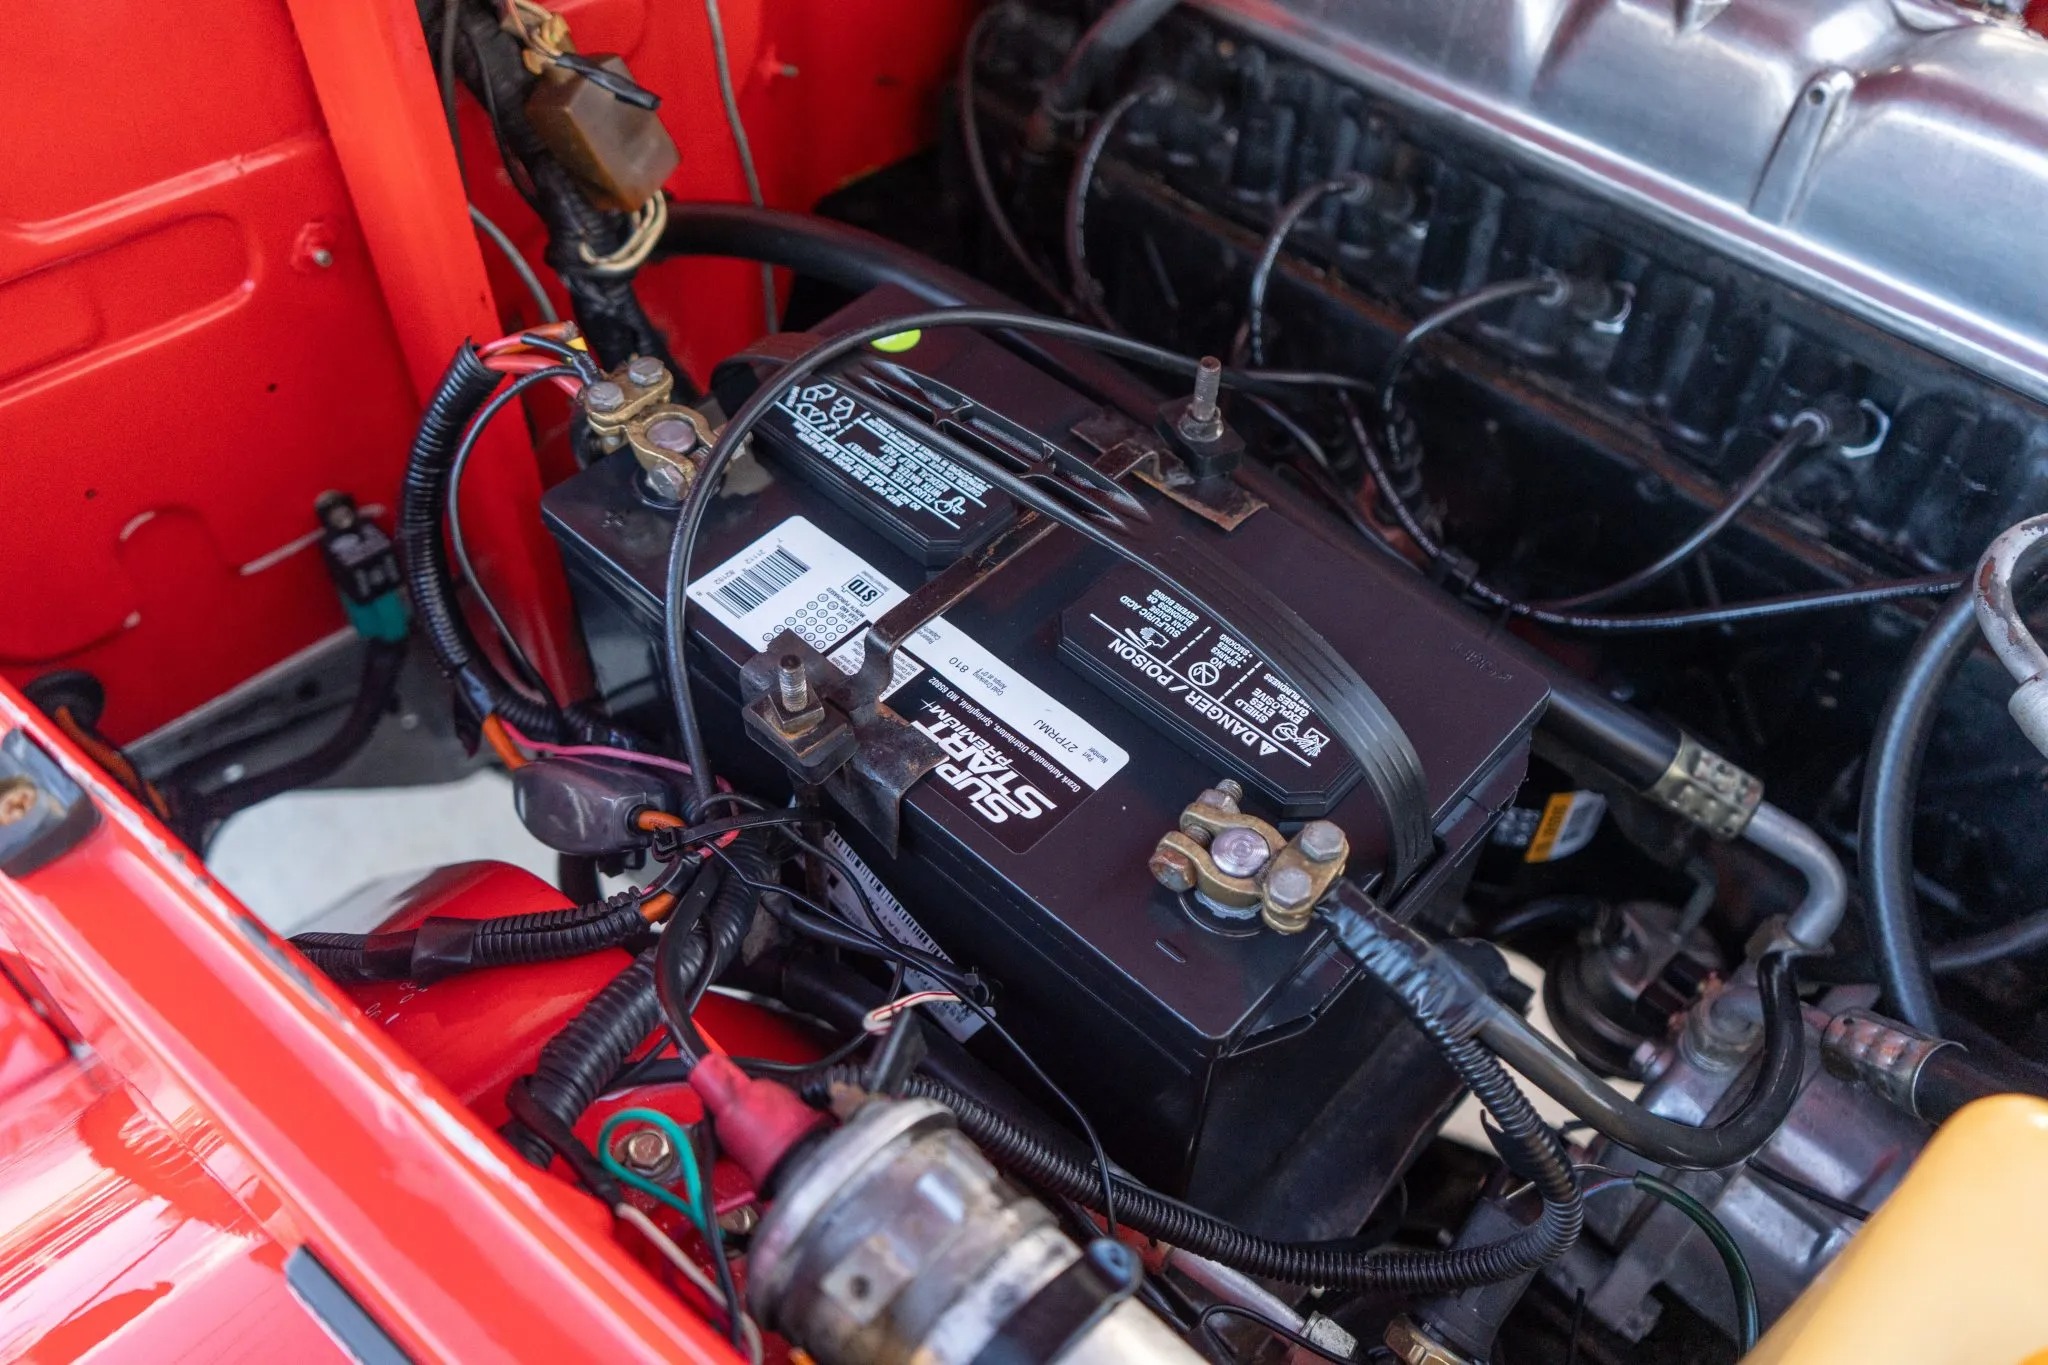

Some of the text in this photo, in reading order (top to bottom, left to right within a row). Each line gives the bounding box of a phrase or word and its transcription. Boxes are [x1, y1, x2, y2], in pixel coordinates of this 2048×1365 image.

[821, 450, 836, 459] OF
[877, 442, 902, 459] FAST
[878, 453, 899, 467] GET
[843, 440, 936, 503] FLUSH EYES IMMEDIATELY
[896, 454, 921, 471] HELP
[861, 477, 876, 487] OF
[870, 483, 889, 496] OUT
[915, 468, 951, 492] MEDICAL
[920, 481, 943, 497] WITH
[895, 492, 912, 504] NOT
[907, 501, 922, 511] DO
[825, 586, 851, 606] PURCHASED
[845, 577, 879, 602] STD
[835, 610, 847, 619] OUT
[838, 605, 861, 621] YEAR AND
[849, 605, 866, 618] MONTH
[1144, 593, 1194, 626] BLINDNESS OR
[1150, 588, 1200, 621] SEVERE BURNS
[1118, 594, 1182, 638] SULFURIC ACID
[1148, 604, 1188, 631] CAN CAUSE
[947, 655, 970, 673] 810
[1107, 637, 1175, 685] POISON
[1208, 656, 1226, 668] NO
[971, 670, 1004, 696] Cold Cranking
[991, 677, 1007, 689] Amps
[1261, 672, 1302, 700] BLINDNESS
[1233, 697, 1269, 723] SHIELD
[1248, 696, 1276, 717] EYES
[1250, 687, 1304, 724] EXPLOSIVE
[1274, 692, 1310, 717] GASES
[1182, 689, 1260, 746] DANGER
[927, 676, 1082, 793] Ozark Automotive Distributors, Springfield, MO 65802
[1032, 718, 1078, 753] 27PRMJ
[1080, 751, 1094, 762] Part
[1086, 746, 1108, 763] Number
[910, 720, 1057, 820] START
[934, 755, 1009, 823] SUP
